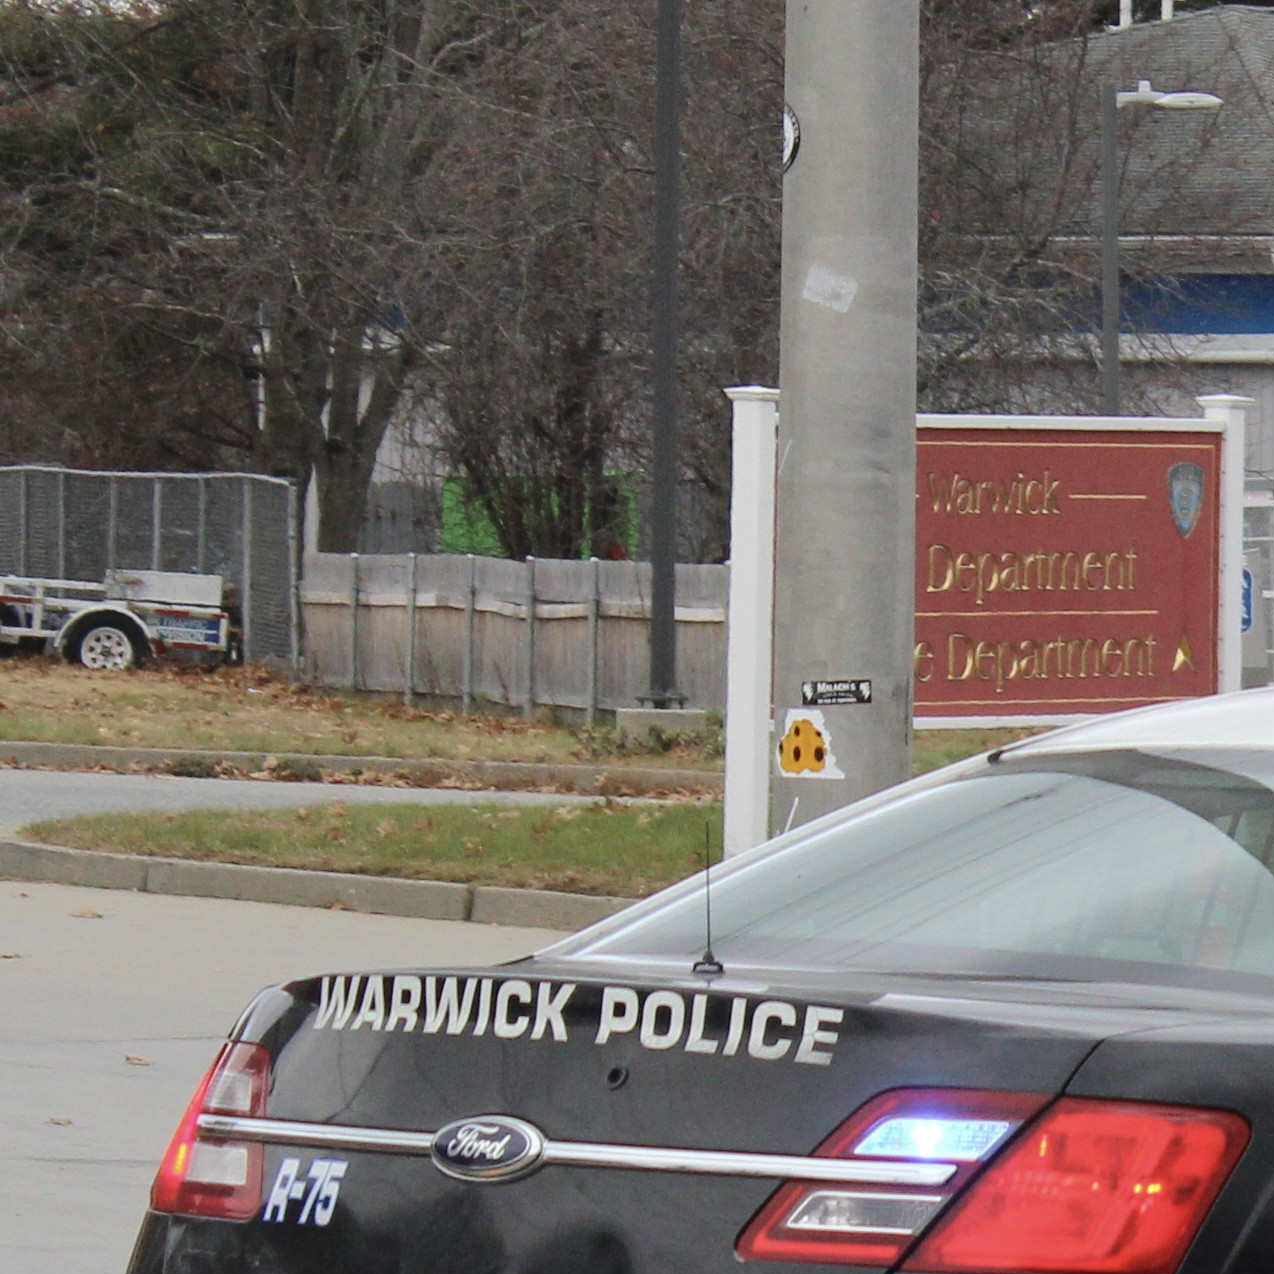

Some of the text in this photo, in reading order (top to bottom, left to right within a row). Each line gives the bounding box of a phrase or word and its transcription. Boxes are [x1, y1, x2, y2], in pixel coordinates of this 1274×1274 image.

[927, 469, 1062, 515] Warwick
[926, 543, 1138, 605] Department
[946, 633, 1157, 693] Department
[313, 974, 845, 1066] WARWICK POLICE
[446, 1123, 512, 1161] Ford
[262, 1157, 350, 1228] R-75
